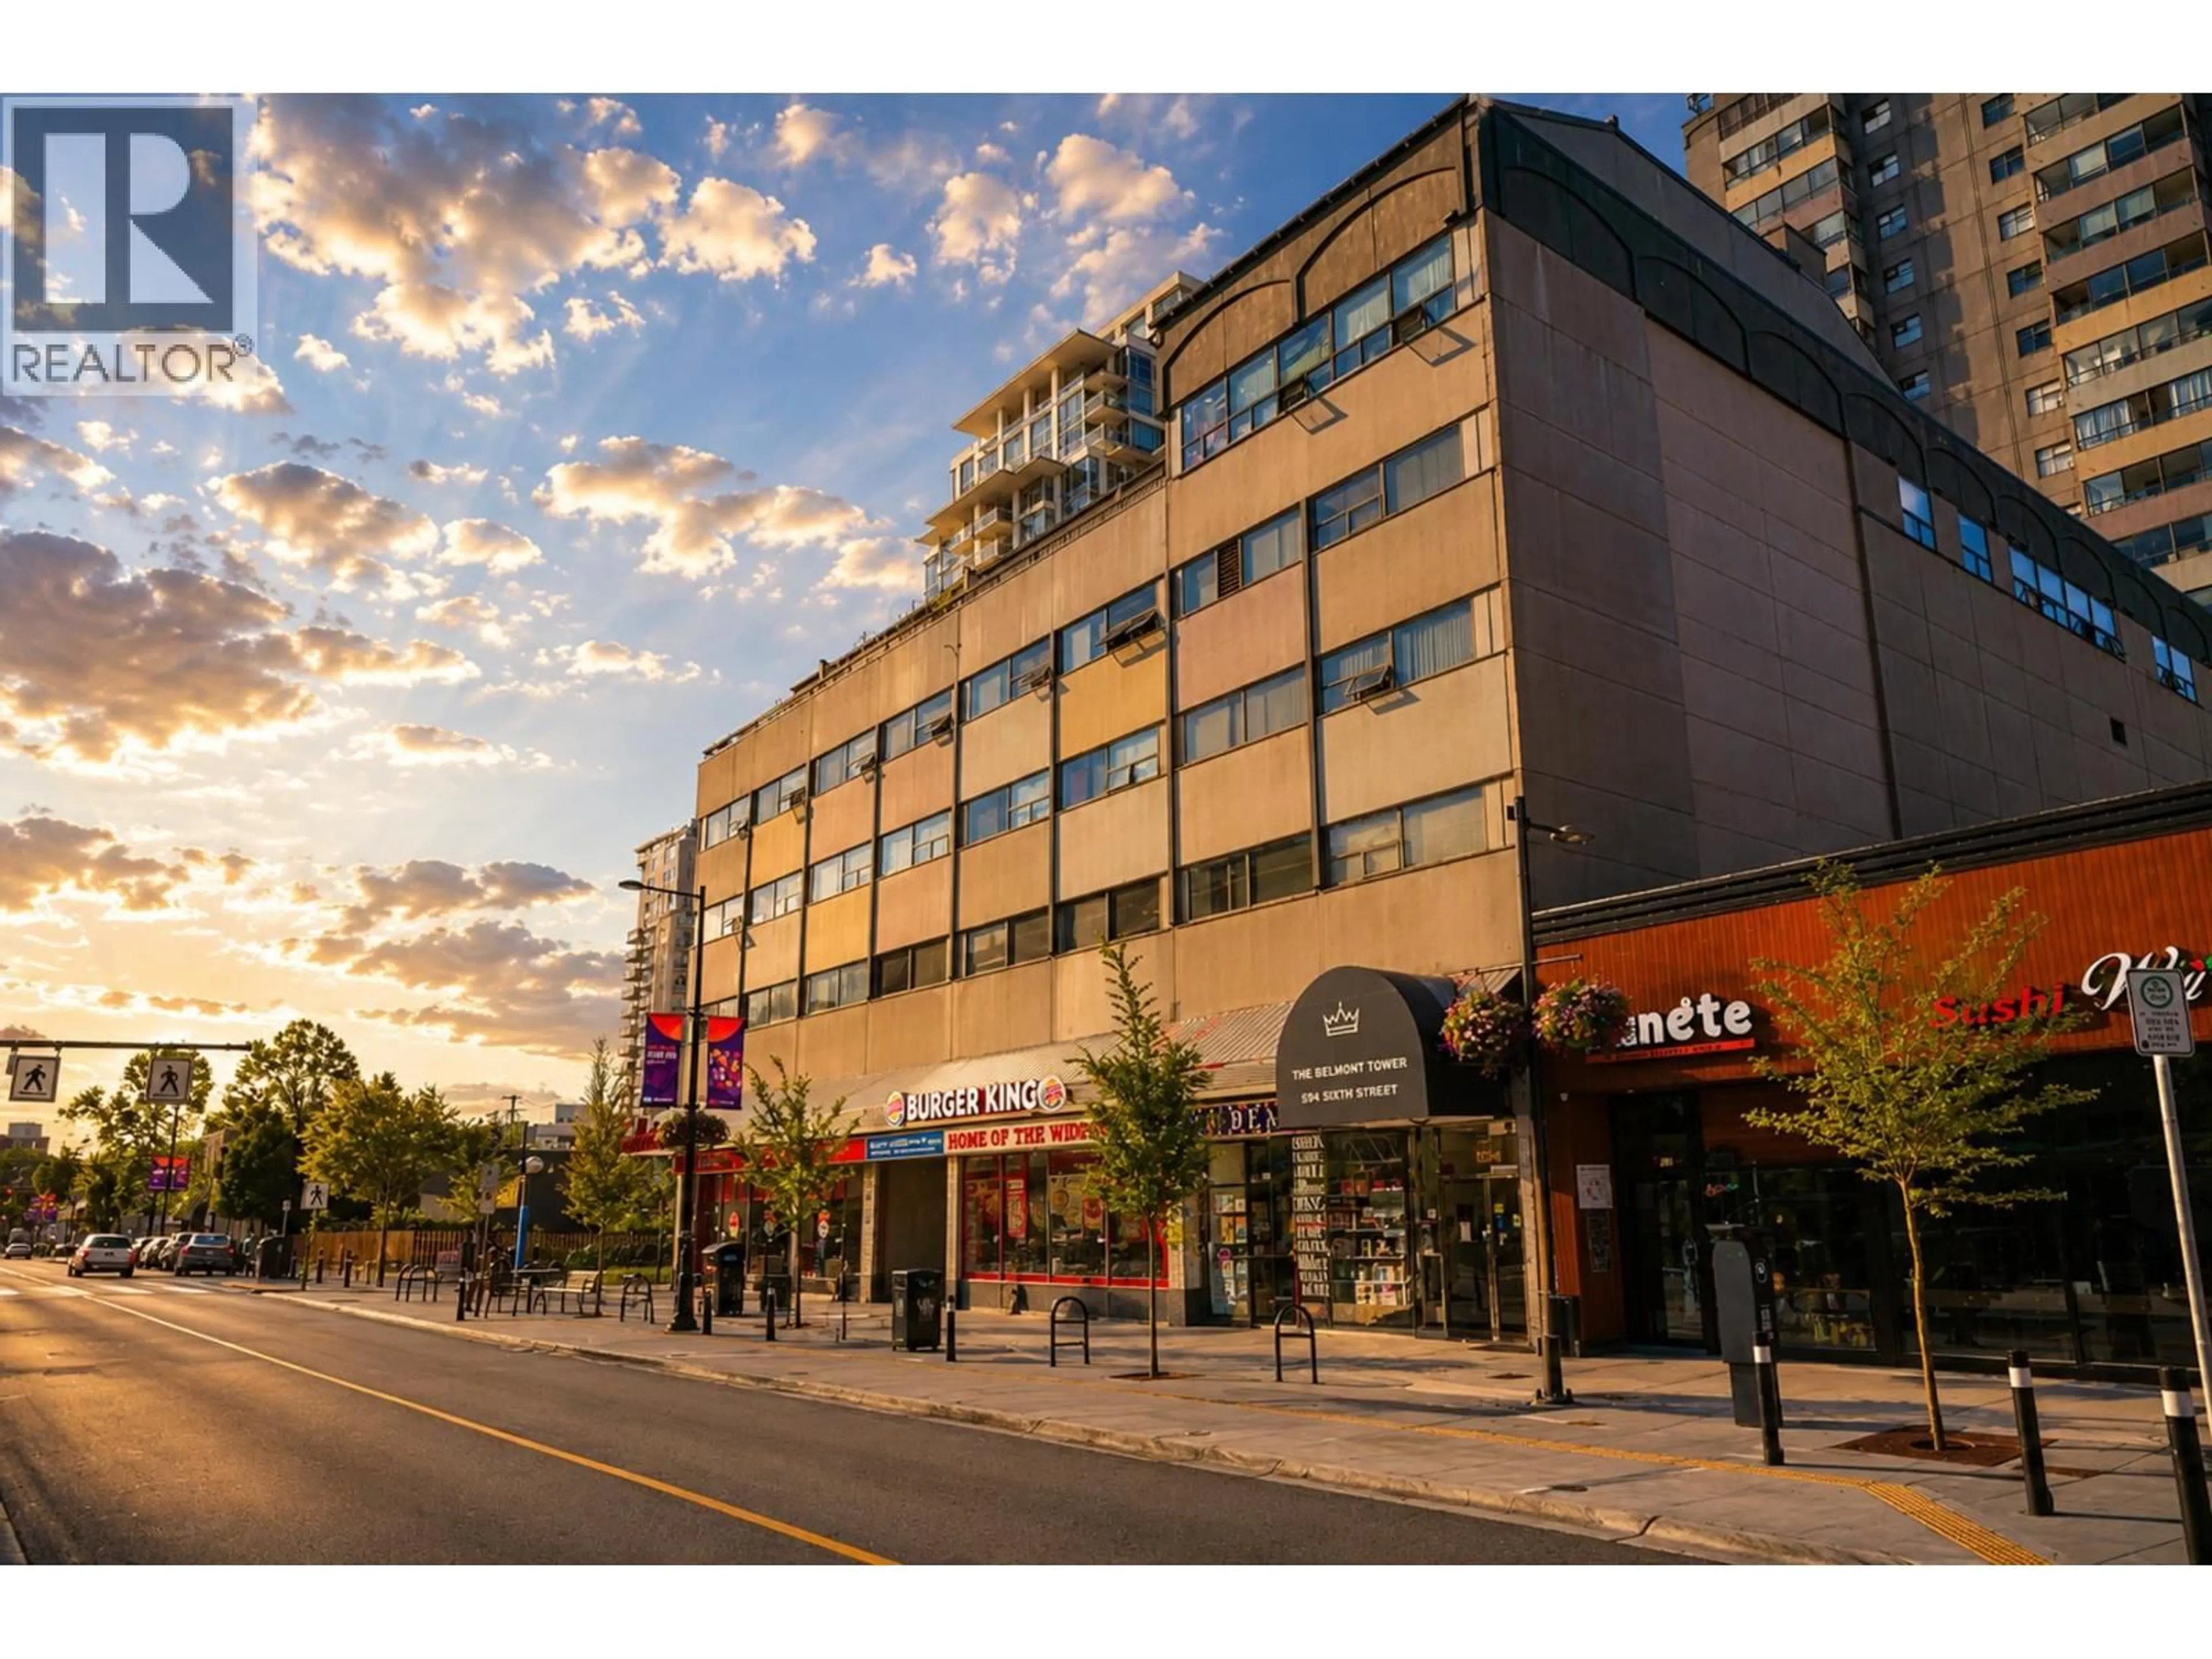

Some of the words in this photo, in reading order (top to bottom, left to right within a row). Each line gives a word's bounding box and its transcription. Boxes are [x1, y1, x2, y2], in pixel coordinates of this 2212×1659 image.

[1927, 983, 2064, 1028] Sushi
[1291, 1068, 1313, 1080] THE
[1315, 1062, 1365, 1078] BELMONT
[1366, 1056, 1408, 1072] TOWER
[906, 1086, 979, 1121] BURGER
[985, 1079, 1038, 1113] KING
[1323, 1088, 1354, 1101] SIXTH
[1355, 1084, 1399, 1099] STREET
[948, 1130, 988, 1150] HOME
